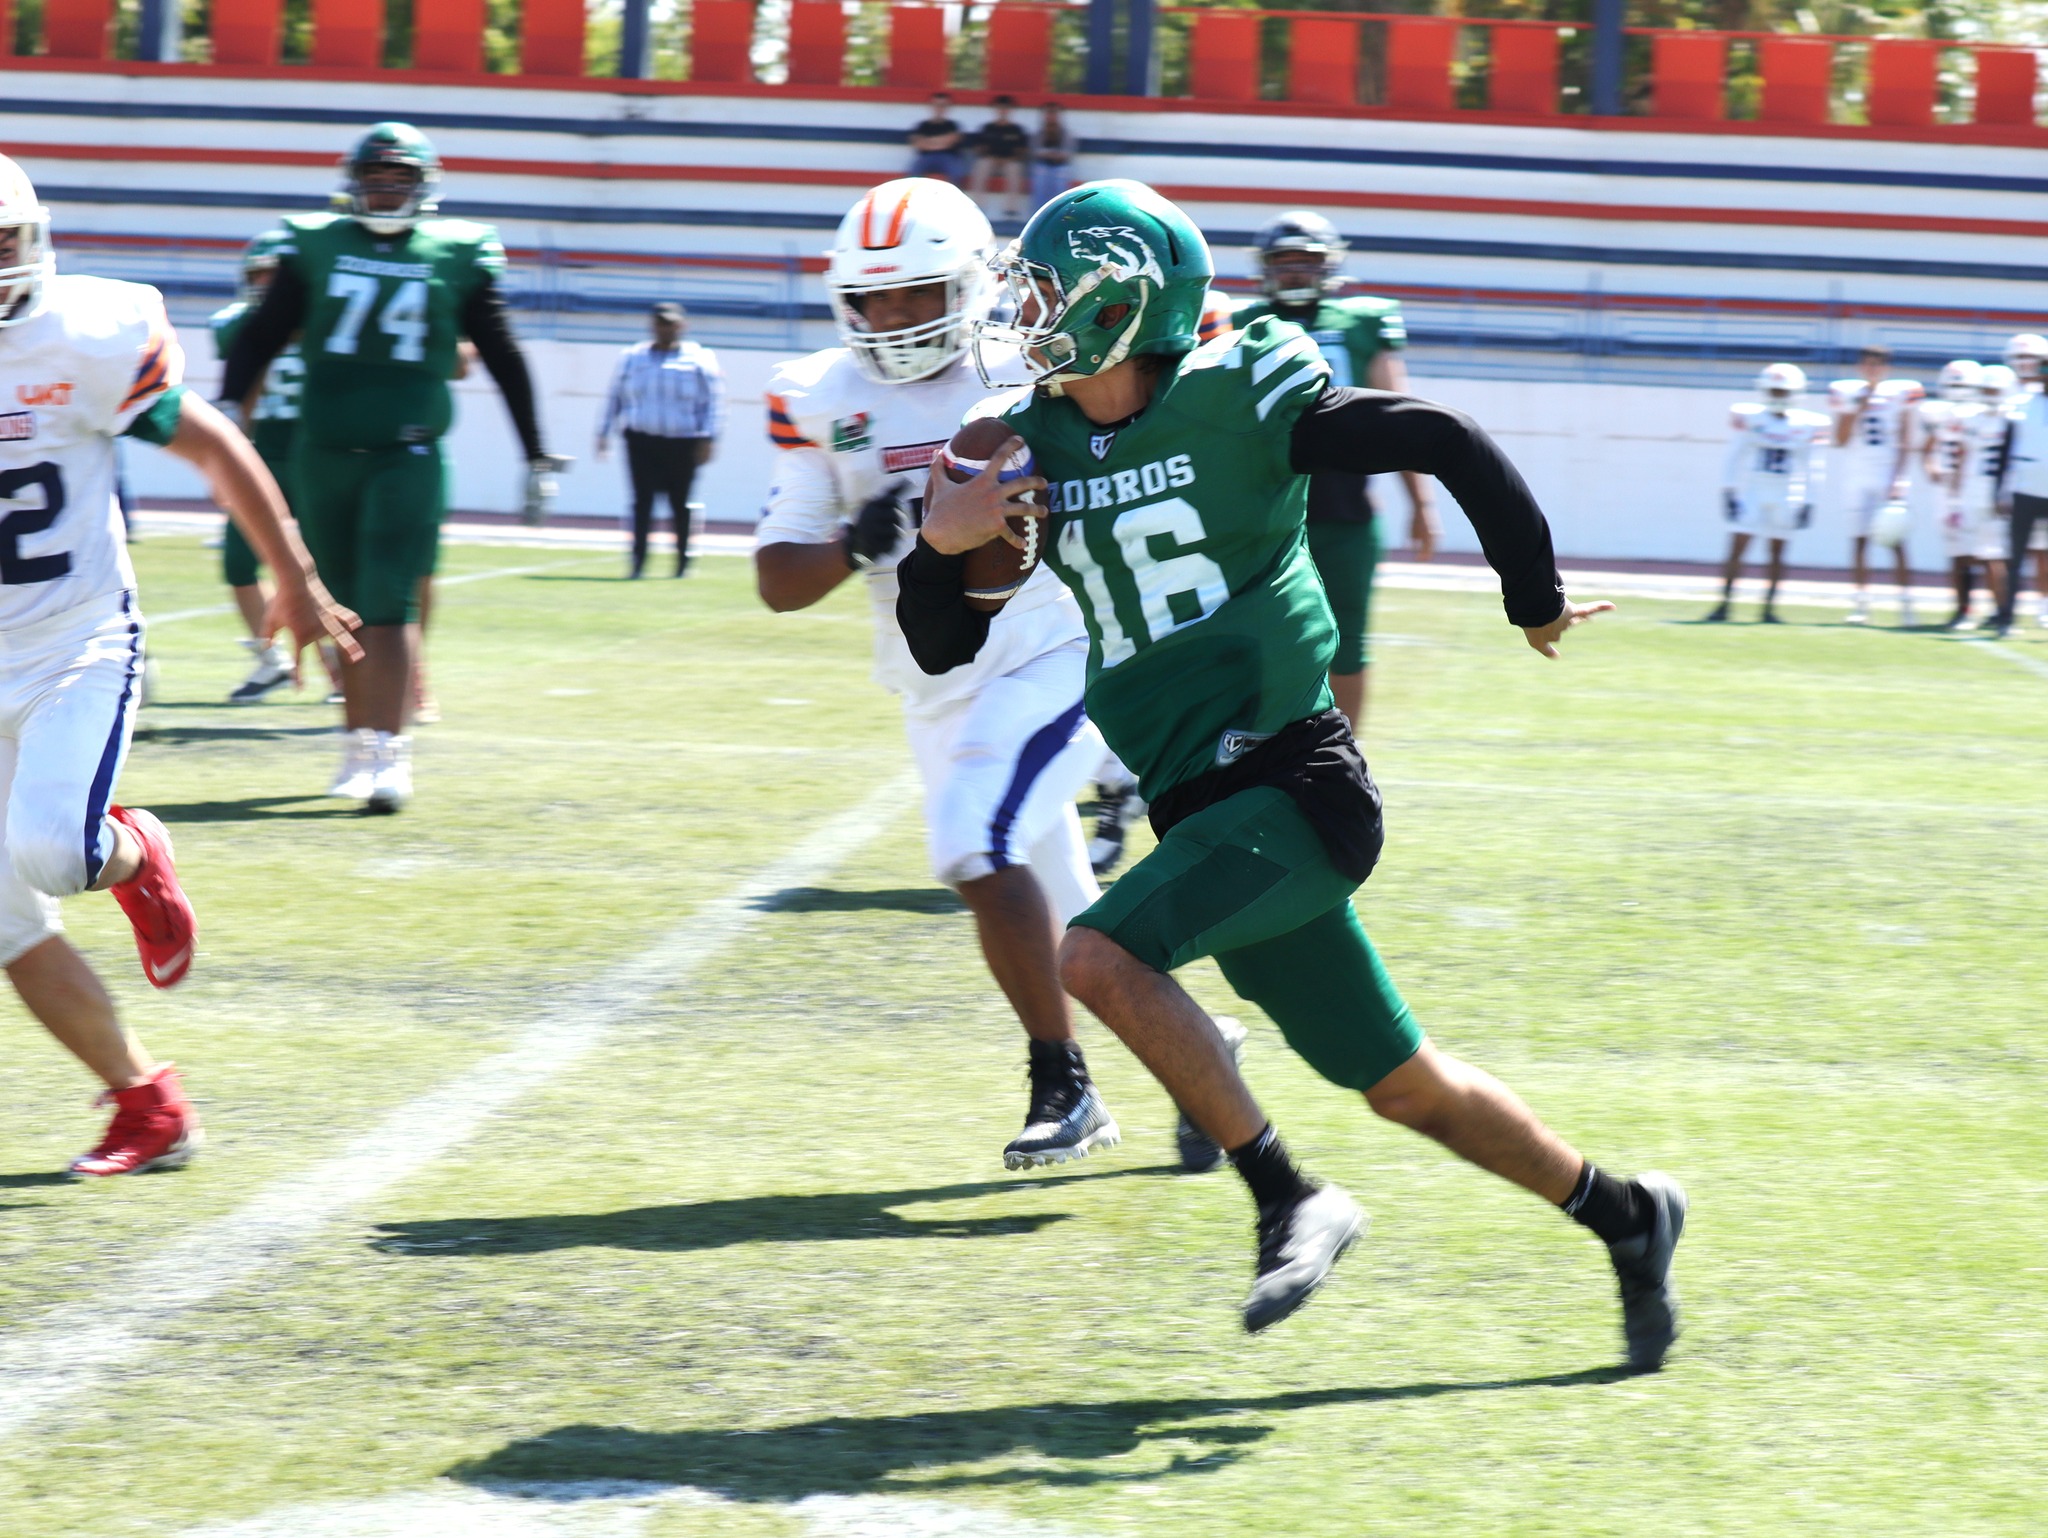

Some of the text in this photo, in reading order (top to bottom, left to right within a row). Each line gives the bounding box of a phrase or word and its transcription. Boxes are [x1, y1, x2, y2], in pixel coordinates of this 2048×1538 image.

[324, 272, 429, 361] 74
[0, 461, 72, 585] 2
[1047, 453, 1196, 514] ZORROS
[1057, 496, 1231, 669] 16
